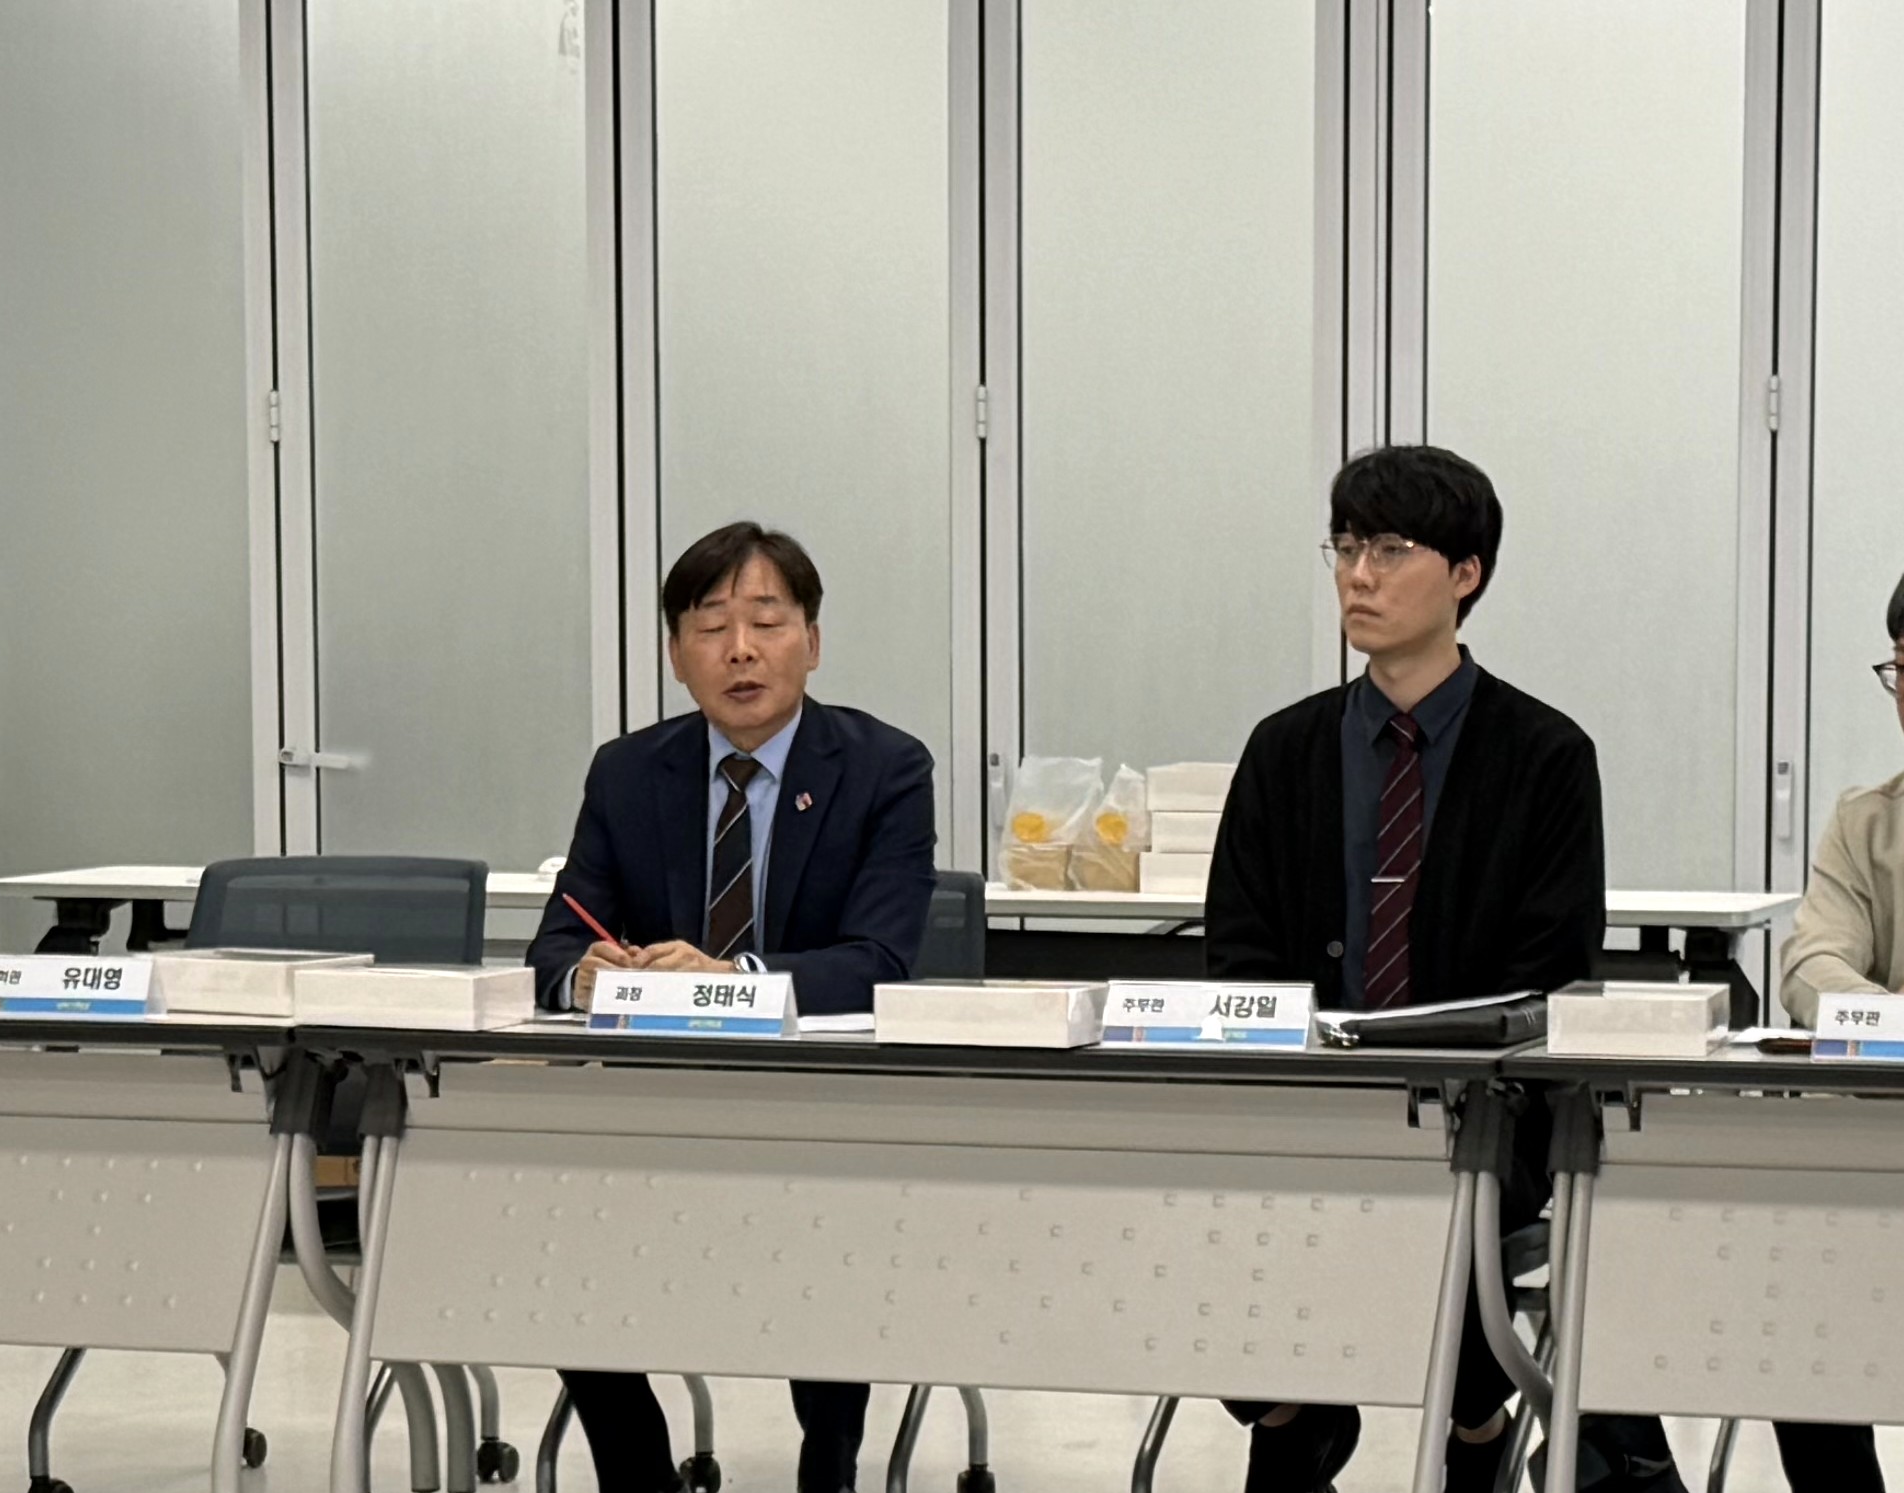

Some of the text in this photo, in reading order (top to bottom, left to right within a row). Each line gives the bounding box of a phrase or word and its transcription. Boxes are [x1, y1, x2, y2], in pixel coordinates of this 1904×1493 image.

[62, 967, 123, 990] 유대영
[693, 984, 757, 1008] 정태식
[1835, 1010, 1880, 1026] 주무관
